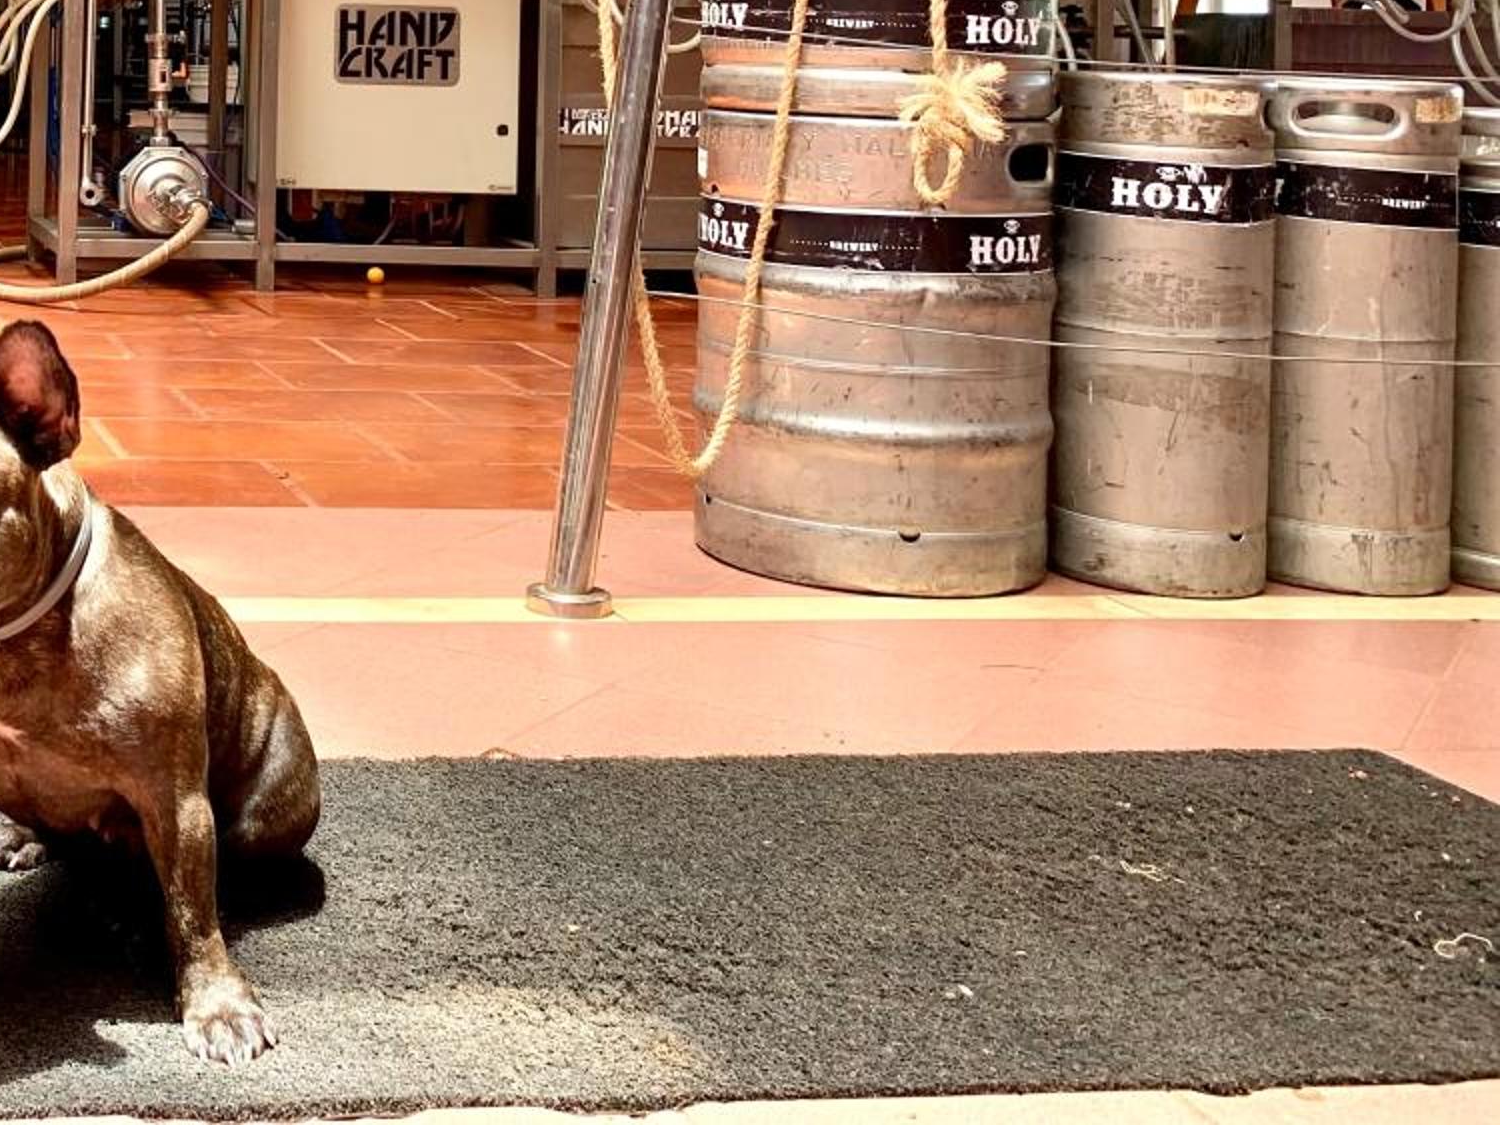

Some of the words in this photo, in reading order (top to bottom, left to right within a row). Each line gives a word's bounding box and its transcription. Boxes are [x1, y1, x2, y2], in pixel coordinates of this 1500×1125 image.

[339, 9, 458, 53] HAND
[965, 14, 1043, 47] HOLY
[339, 46, 456, 81] CRAFT
[1111, 176, 1225, 215] HOLY
[968, 234, 1043, 266] HOLY
